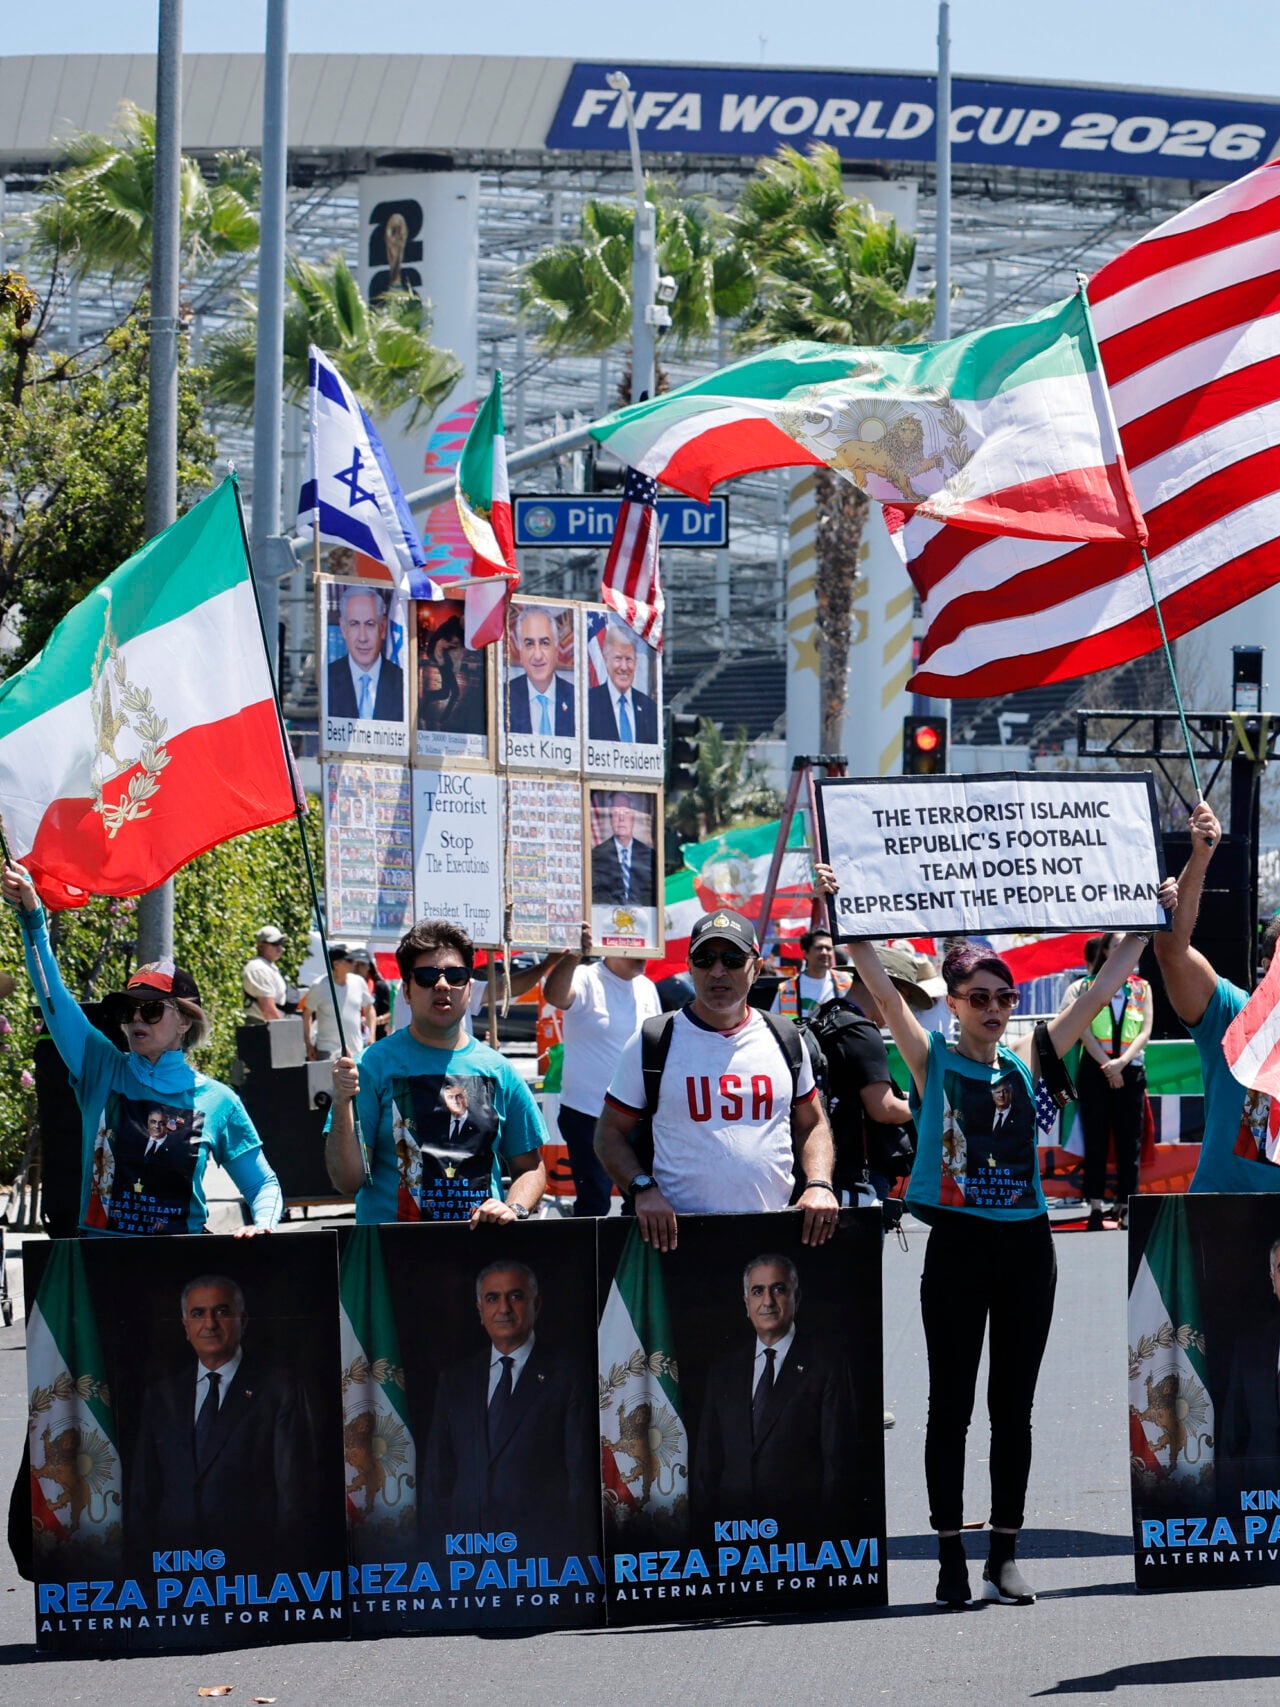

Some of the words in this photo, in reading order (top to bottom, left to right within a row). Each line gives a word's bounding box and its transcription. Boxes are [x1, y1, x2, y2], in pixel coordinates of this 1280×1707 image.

[572, 89, 701, 131] FIFA
[719, 94, 935, 140] WORLD
[949, 104, 1061, 146] CUP
[1060, 112, 1267, 160] 2026
[568, 507, 669, 539] Piny
[682, 508, 715, 535] Dr
[327, 720, 346, 742] Best
[348, 722, 371, 744] Prime
[373, 727, 406, 747] minister
[507, 738, 536, 758] Best
[540, 740, 572, 765] King
[588, 745, 611, 767] Best
[613, 749, 661, 770] President
[438, 774, 473, 796] IRGC
[423, 791, 487, 815] Terrorist
[873, 809, 911, 828] THE
[915, 802, 1025, 826] TERRORIST
[1031, 801, 1110, 821] ISLAMIC
[440, 830, 474, 856] Stop
[884, 832, 1000, 856] REPUBLIC'S
[1006, 829, 1107, 849] FOOTBALL
[425, 853, 442, 873] The
[446, 853, 490, 874] Executions
[920, 859, 977, 882] TEAM
[983, 858, 1036, 878] DOES
[1042, 857, 1083, 876] NOT
[840, 890, 955, 915] REPRESENT
[961, 888, 998, 908] THE
[1004, 885, 1076, 905] PEOPLE
[1082, 884, 1108, 902] OF
[1113, 882, 1160, 901] IRAN
[423, 901, 460, 918] President
[463, 903, 491, 923] Trump
[473, 922, 486, 940] Job
[686, 1074, 774, 1122] USA
[714, 1518, 779, 1542] KING
[1141, 1516, 1237, 1548] REZA
[445, 1532, 518, 1555] KING
[152, 1548, 226, 1573] KING
[613, 1548, 710, 1583] REZA
[718, 1537, 879, 1577] PAHLAVI
[38, 1579, 147, 1614] REZA
[157, 1570, 342, 1609] PAHLAVI
[616, 1580, 765, 1601] ALTERNATIVE
[777, 1577, 816, 1591] FOR
[829, 1572, 880, 1587] IRAN
[353, 1596, 501, 1613] LTERNATIVE
[516, 1593, 560, 1606] FOR
[40, 1613, 209, 1632] ALTERNATIVE
[225, 1610, 270, 1625] FOR
[284, 1607, 343, 1622] IRAN
